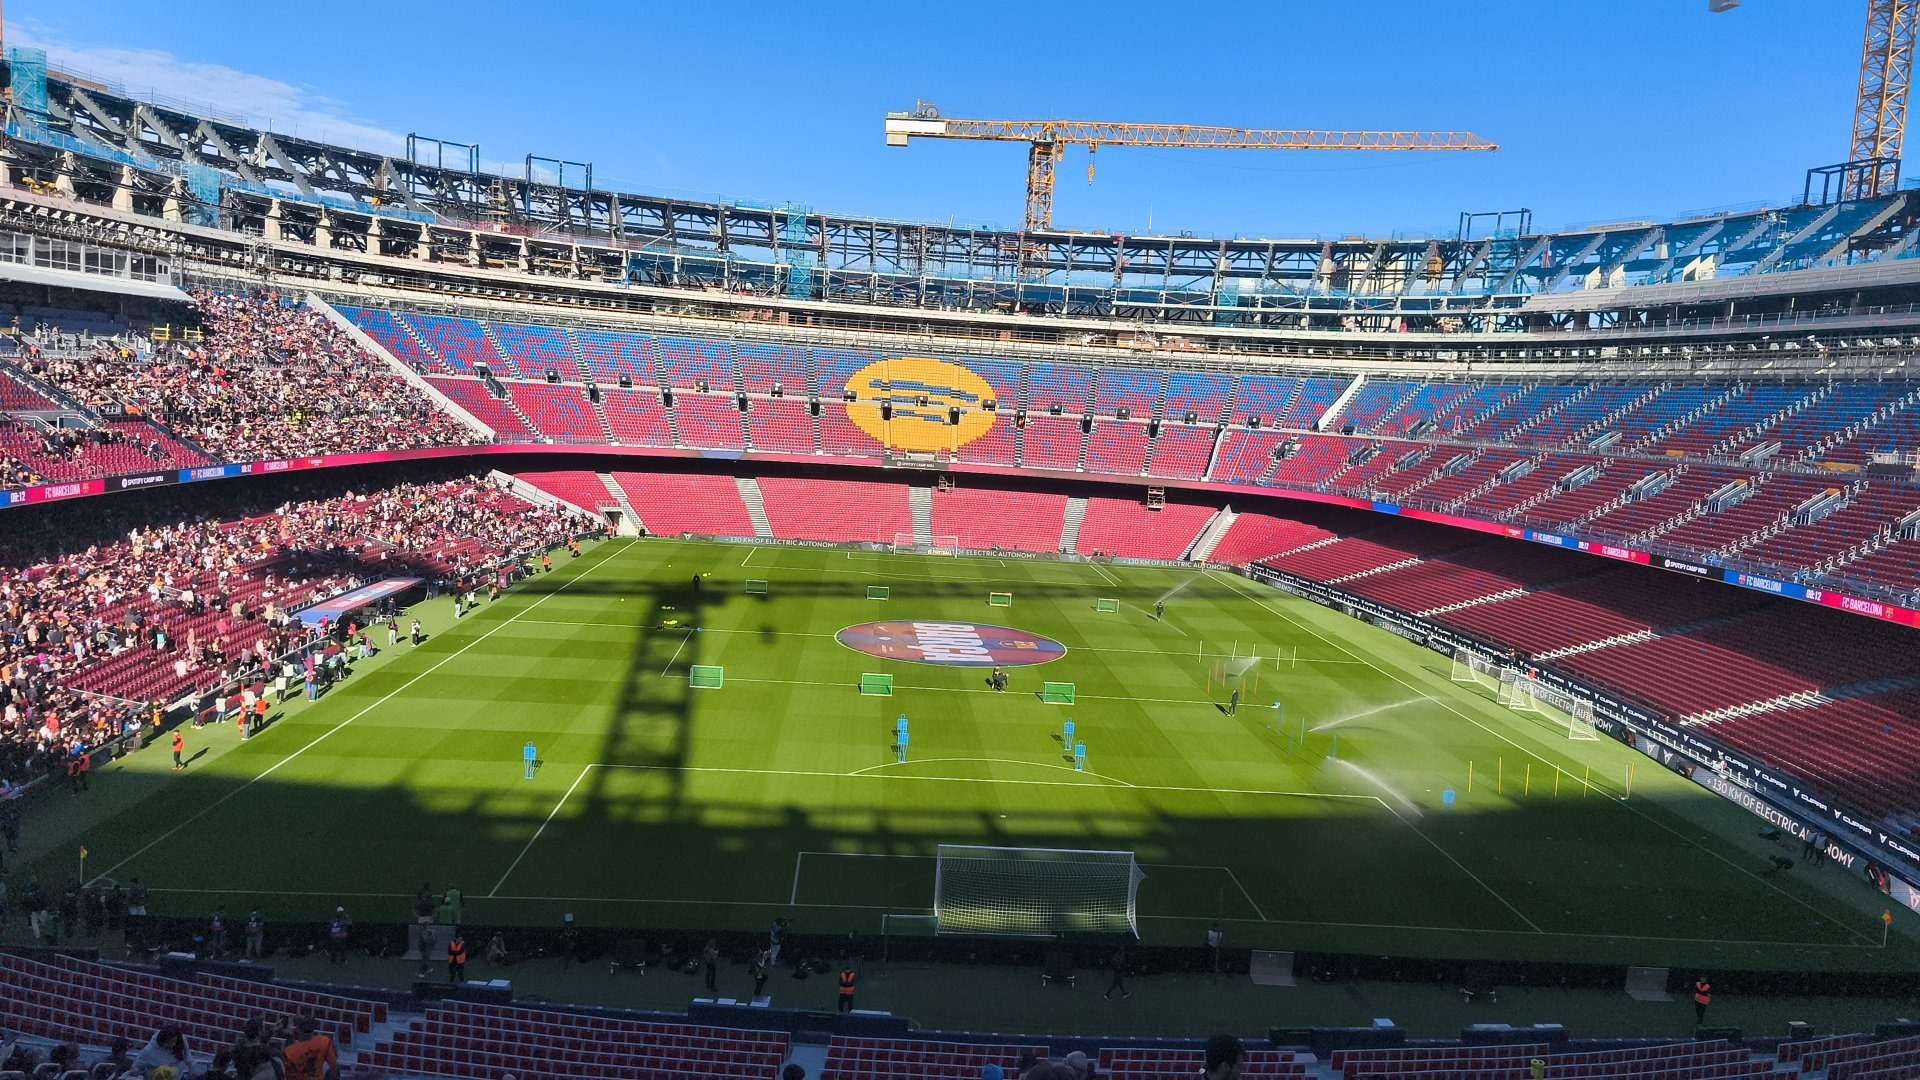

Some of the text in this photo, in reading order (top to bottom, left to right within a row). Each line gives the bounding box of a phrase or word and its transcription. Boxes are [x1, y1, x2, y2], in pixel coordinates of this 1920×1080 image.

[203, 467, 224, 477] BARCELONA
[128, 478, 143, 486] SPOTIFY
[144, 476, 154, 484] CAMP
[45, 484, 80, 499] FC BARCELONA
[765, 538, 797, 546] ELECTRIC
[798, 540, 838, 548] AUTONOMY
[966, 549, 996, 557] ELECTRIC
[998, 551, 1037, 559] AUTONOMY
[1161, 560, 1191, 568] ELECTRIC
[1193, 562, 1230, 571] AUTONOMY
[1670, 561, 1686, 570] SPOTIFY
[1746, 575, 1781, 593] FC BARCELONA
[1841, 597, 1883, 617] FC BARCELONA
[1403, 629, 1424, 645] ELECTRIC
[1600, 696, 1618, 708] CUPRA
[1627, 708, 1647, 721] CUPRA
[1658, 723, 1678, 737] CUPRA
[1690, 738, 1712, 752] CUPRA
[1725, 755, 1749, 770] CUPRA
[1761, 773, 1787, 789] CUPRA
[1712, 778, 1728, 794] 130
[1728, 786, 1742, 802] KM
[1743, 794, 1755, 809] OF
[1755, 801, 1798, 835] ELECTRIC
[1801, 793, 1828, 812] CUPRA
[1842, 815, 1872, 835] CUPRA
[1888, 840, 1920, 862] CUPRA
